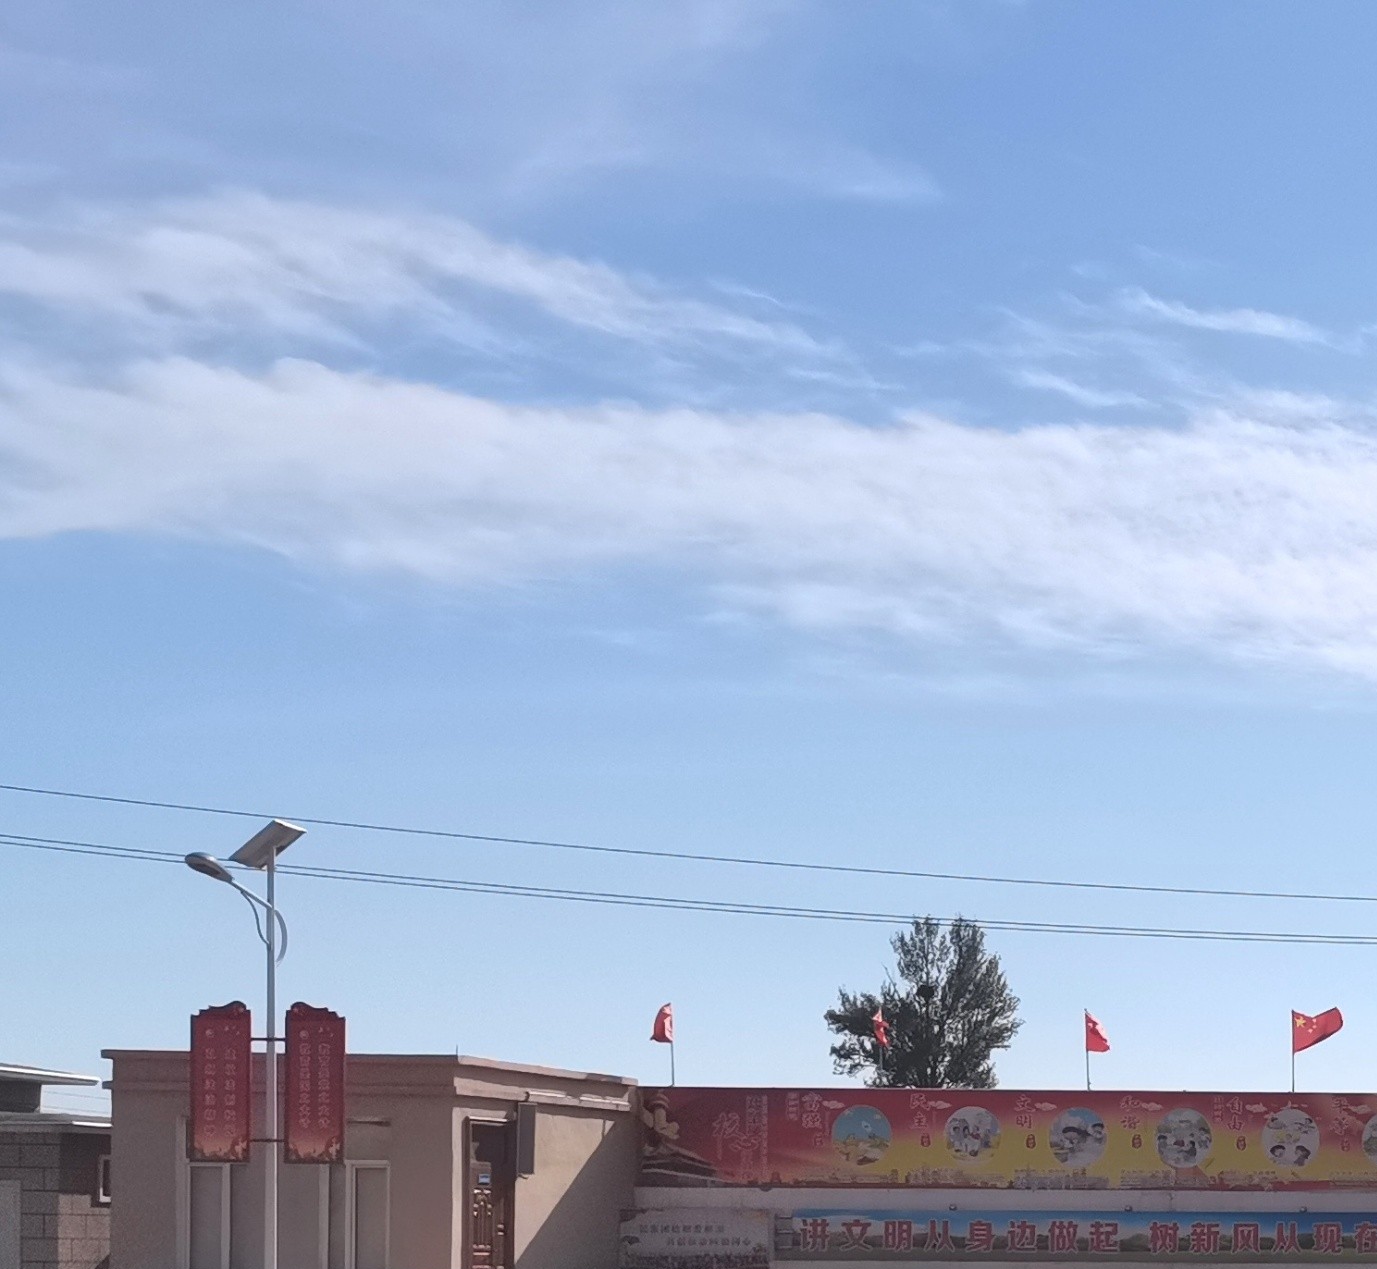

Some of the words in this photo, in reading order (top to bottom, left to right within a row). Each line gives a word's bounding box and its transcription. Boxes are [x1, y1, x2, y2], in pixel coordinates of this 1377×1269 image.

[1013, 1094, 1037, 1130] 文明
[799, 1218, 1120, 1254] 讲文明从身边做起
